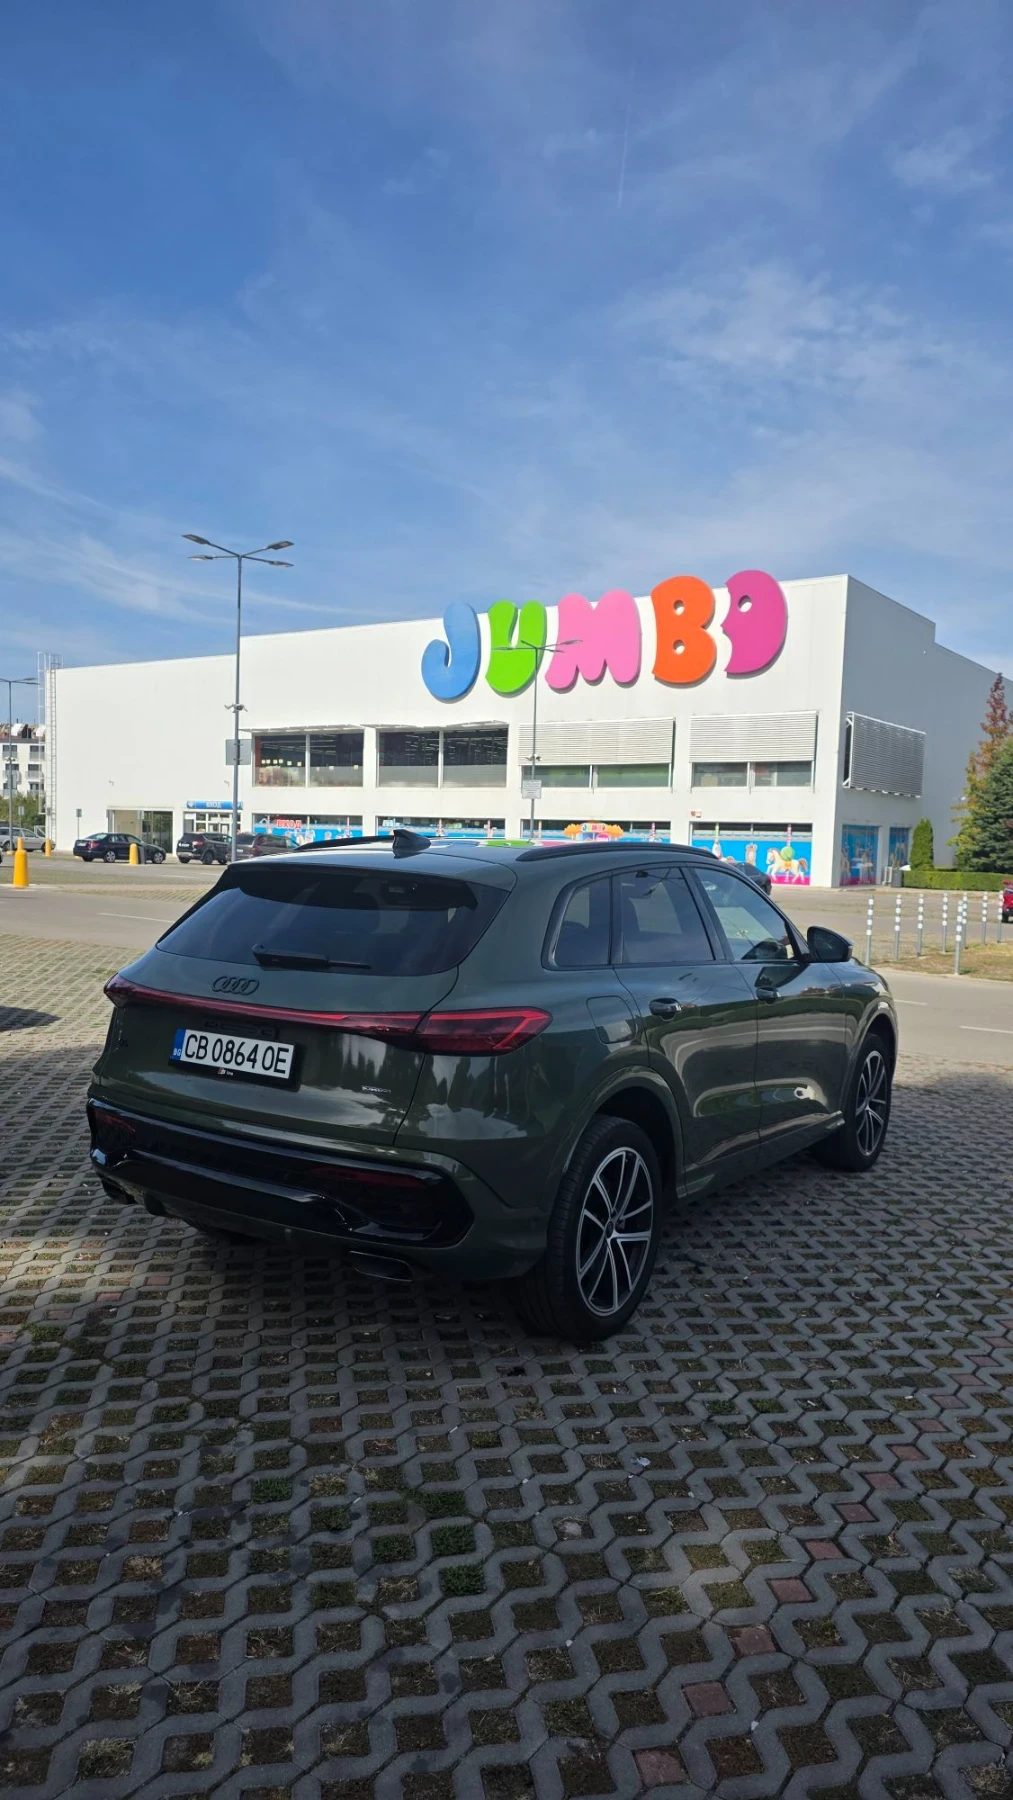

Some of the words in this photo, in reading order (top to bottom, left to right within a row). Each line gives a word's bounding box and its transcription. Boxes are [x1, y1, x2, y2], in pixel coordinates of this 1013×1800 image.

[421, 569, 787, 701] JUMBO
[185, 1034, 209, 1060] CB
[212, 1038, 259, 1069] 0864
